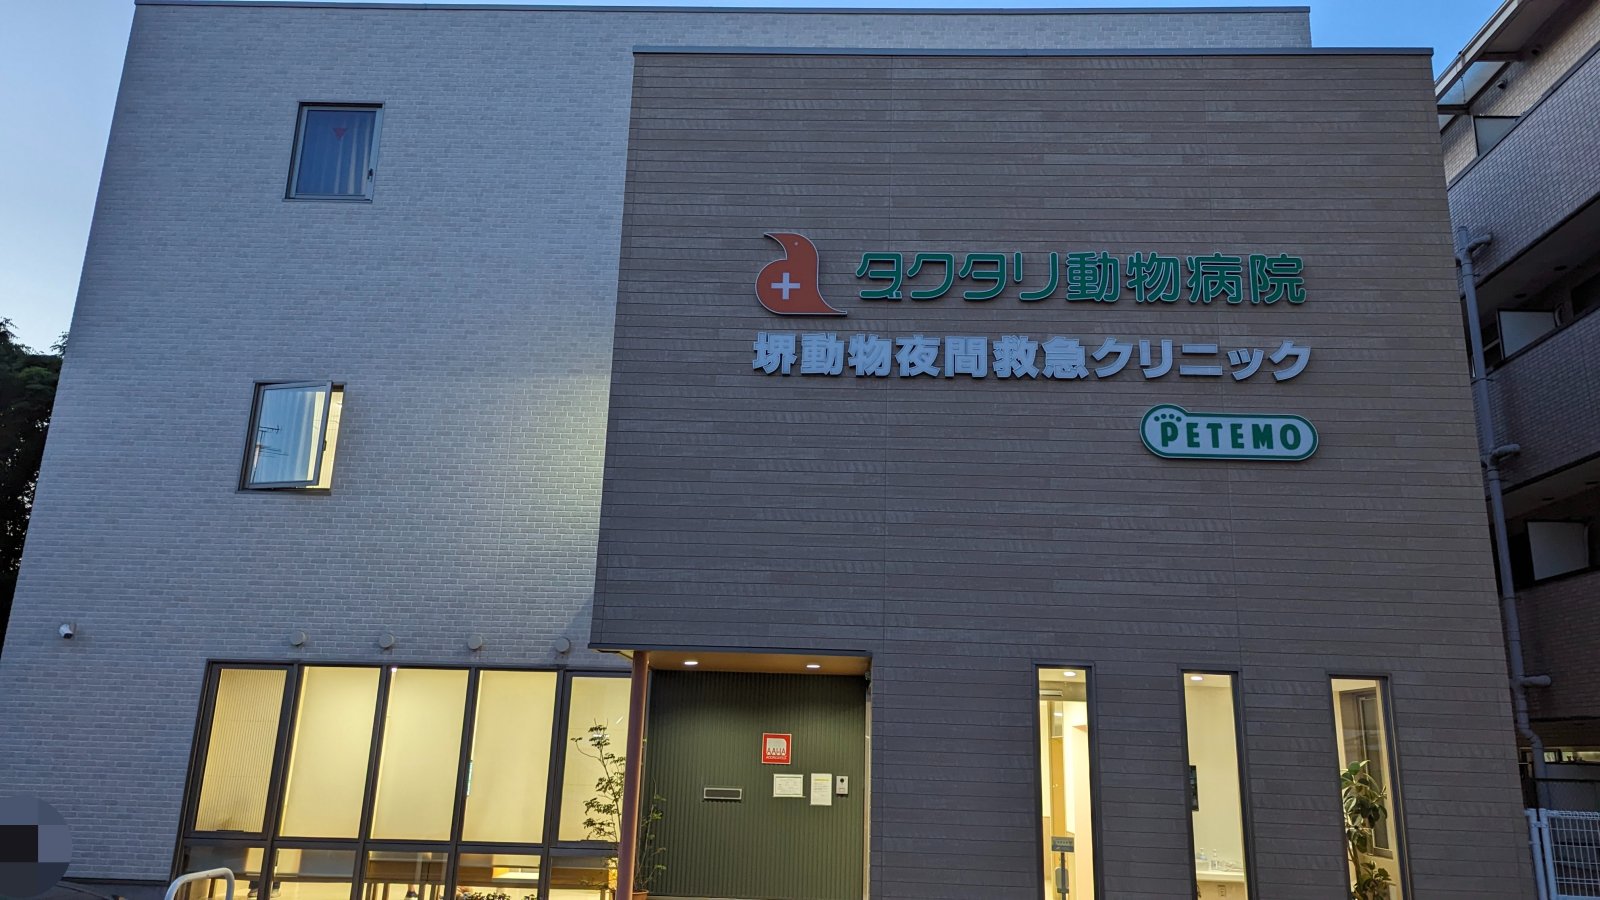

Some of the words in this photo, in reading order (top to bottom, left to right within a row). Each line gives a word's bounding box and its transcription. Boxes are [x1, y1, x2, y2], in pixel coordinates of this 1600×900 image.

[753, 332, 1311, 381] 堺動物夜間救急クリニック
[1160, 421, 1302, 450] PETEMO
